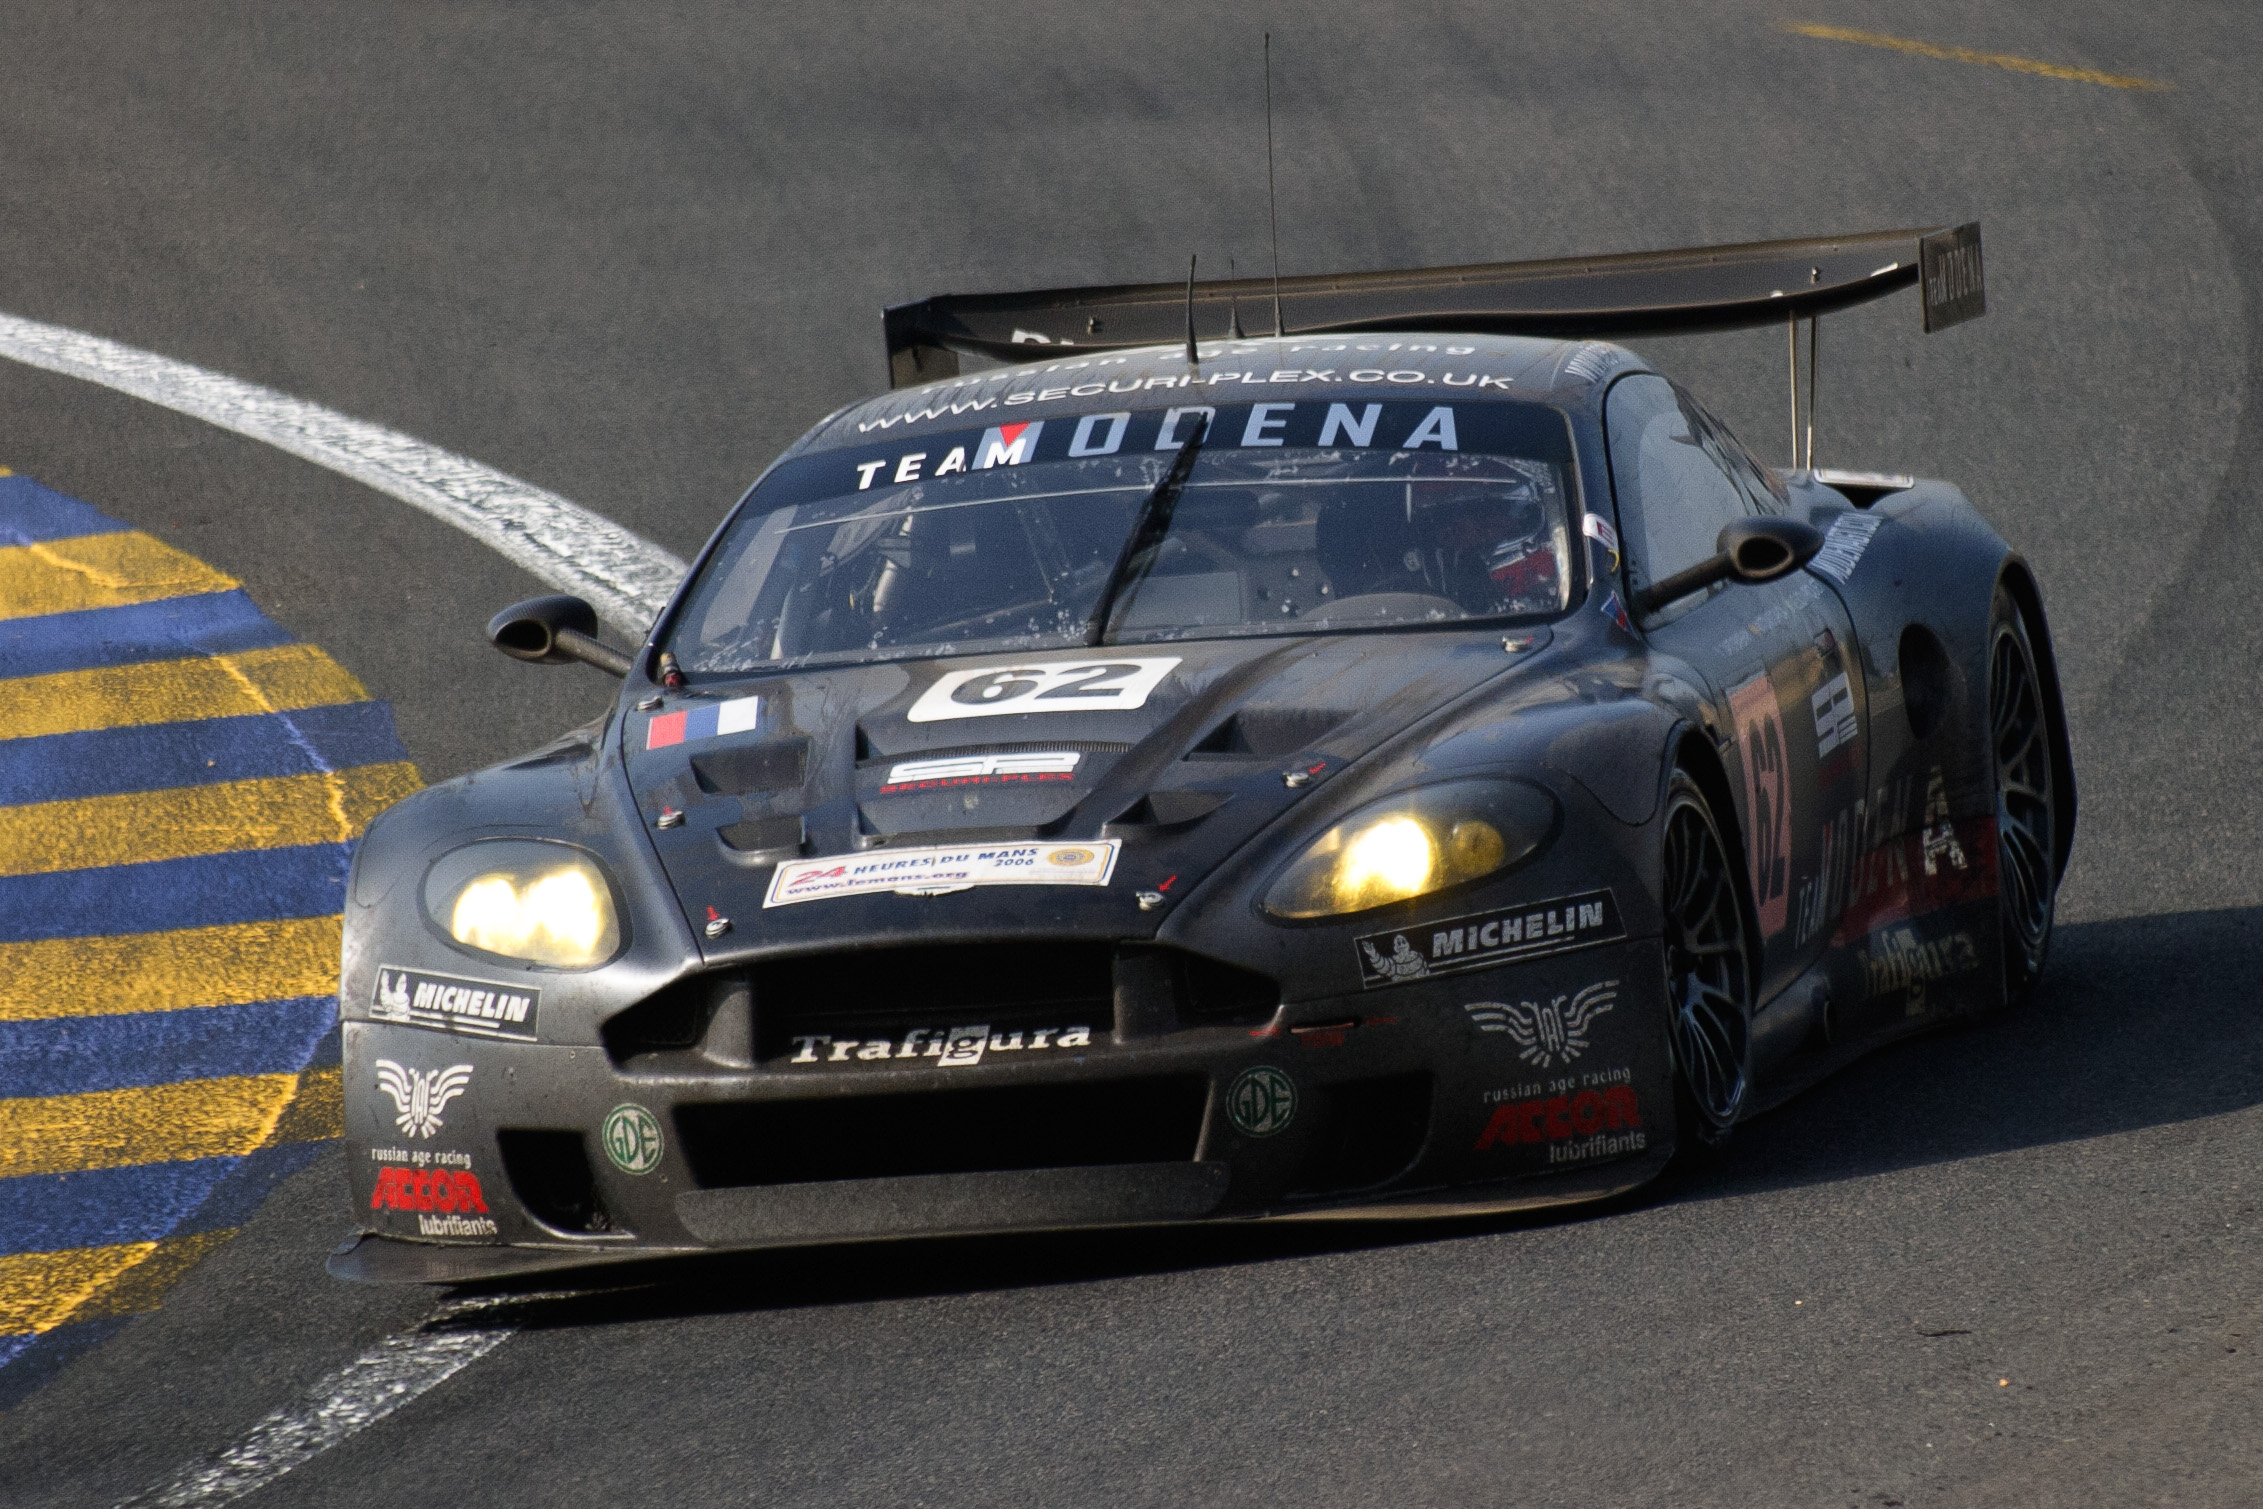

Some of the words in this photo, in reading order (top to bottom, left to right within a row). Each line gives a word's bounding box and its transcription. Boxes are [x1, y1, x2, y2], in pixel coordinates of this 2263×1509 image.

[857, 437, 1024, 491] TEAM
[950, 663, 1143, 706] 62
[788, 865, 848, 887] 24
[854, 858, 931, 875] HEURES
[941, 854, 970, 865] DU
[977, 848, 1039, 860] MANS
[994, 858, 1035, 867] 2006
[786, 870, 970, 895] www.lemans.org
[1432, 902, 1604, 958] MICHELIN
[413, 982, 531, 1023] MICHELIN
[790, 1024, 1091, 1067] Trafigura
[1483, 1081, 1542, 1104] russian
[1549, 1074, 1575, 1097] age
[1583, 1066, 1631, 1089] racing
[371, 1147, 409, 1163] russian
[411, 1151, 432, 1168] age
[435, 1149, 472, 1168] racing
[1549, 1130, 1646, 1164] lubrifiants
[418, 1214, 498, 1237] lubrifiants
